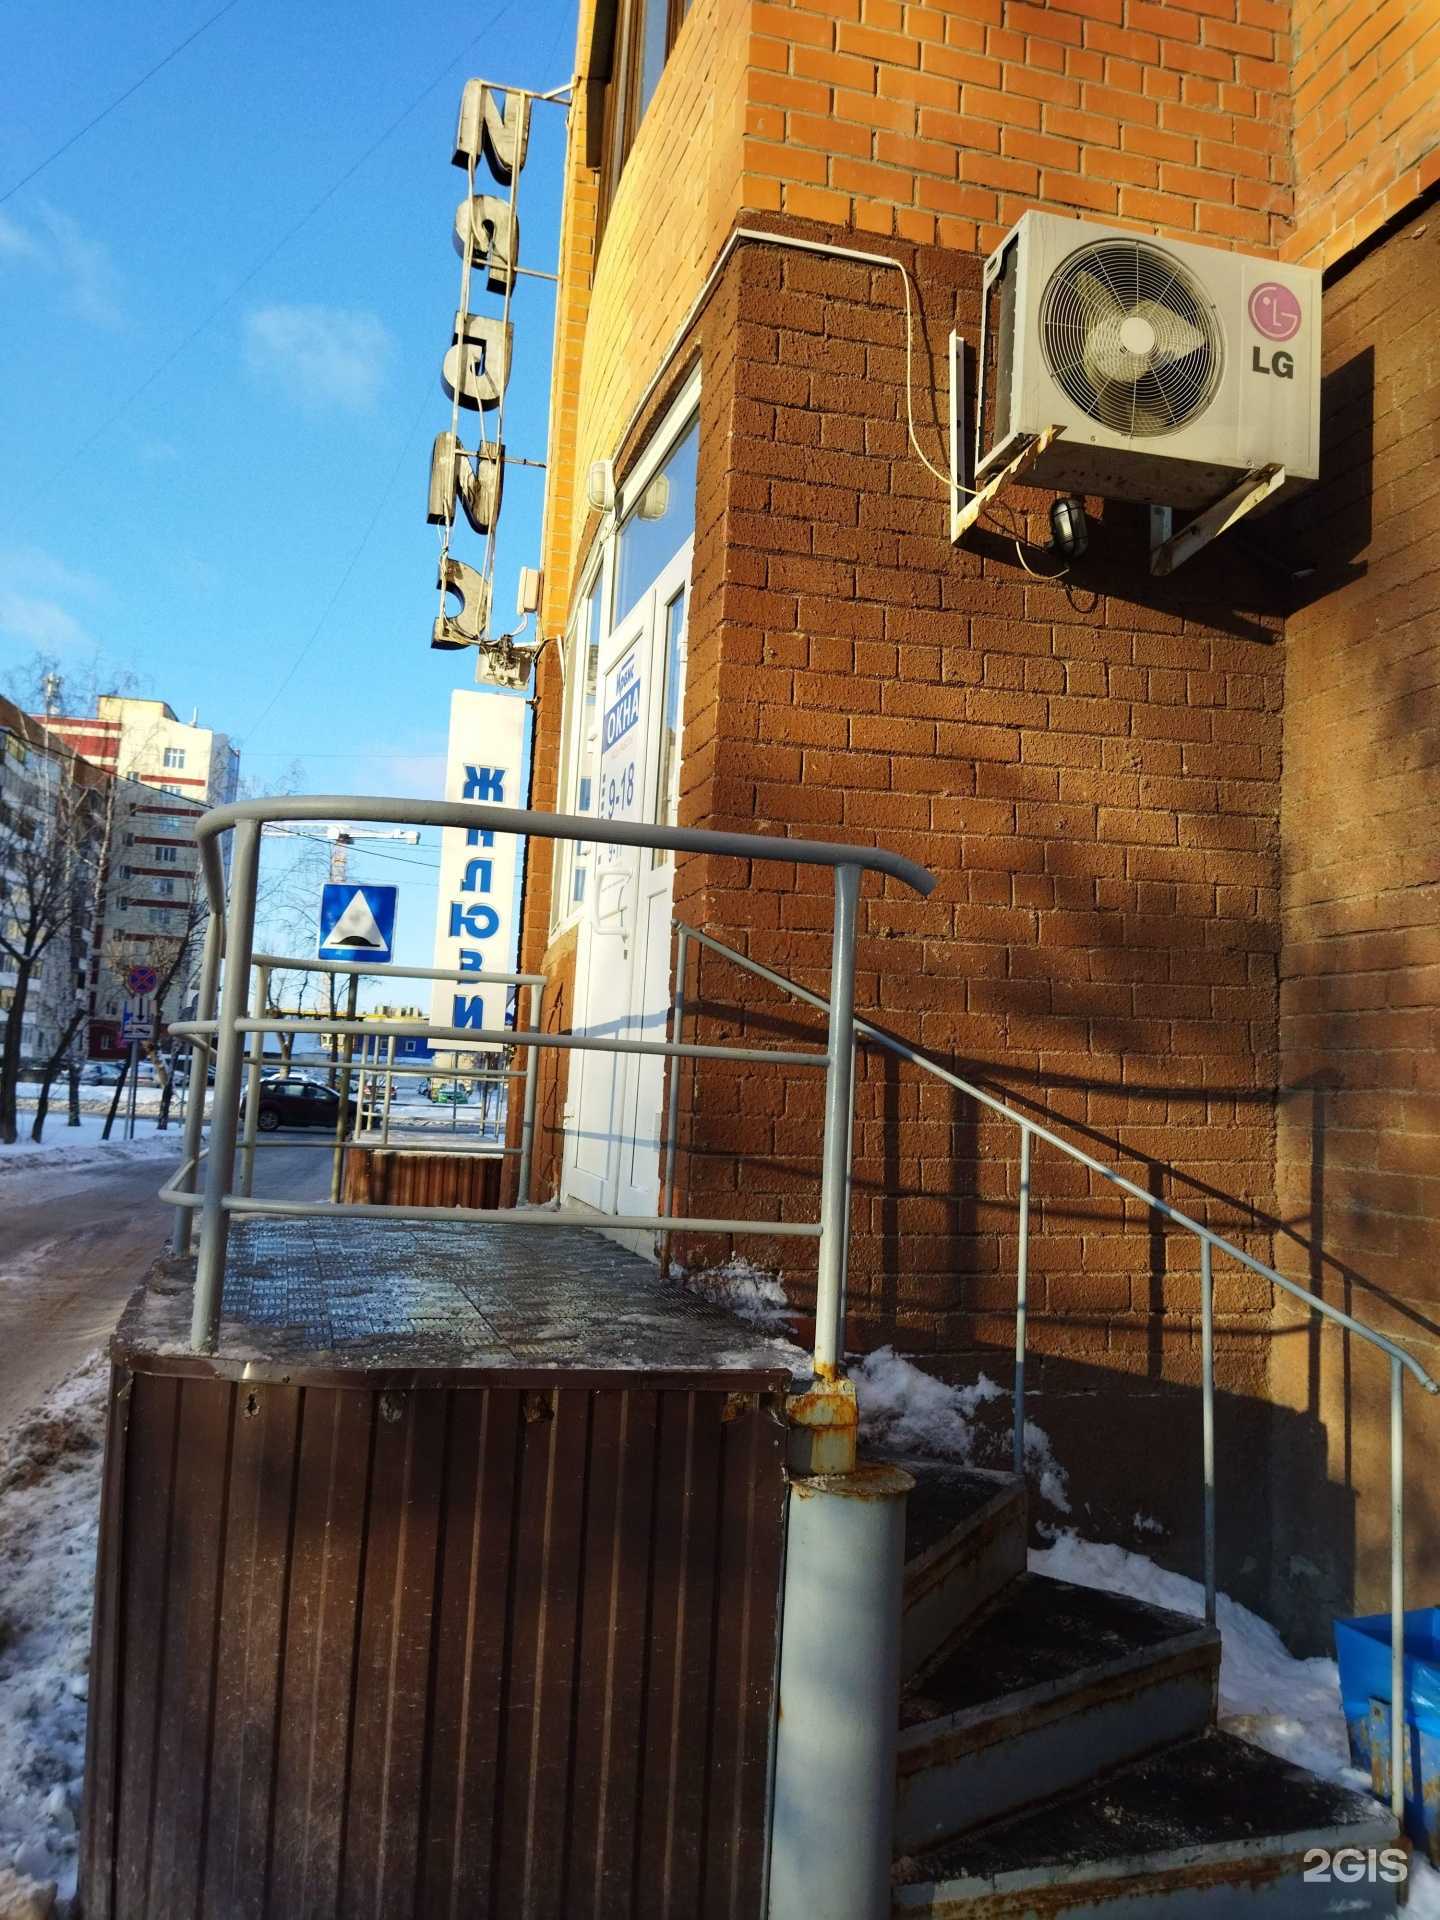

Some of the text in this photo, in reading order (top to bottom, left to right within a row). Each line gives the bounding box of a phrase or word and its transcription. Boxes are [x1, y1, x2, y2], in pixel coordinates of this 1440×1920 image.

[1252, 345, 1294, 379] LG
[607, 686, 640, 744] ОКНА
[608, 762, 635, 820] 9-18
